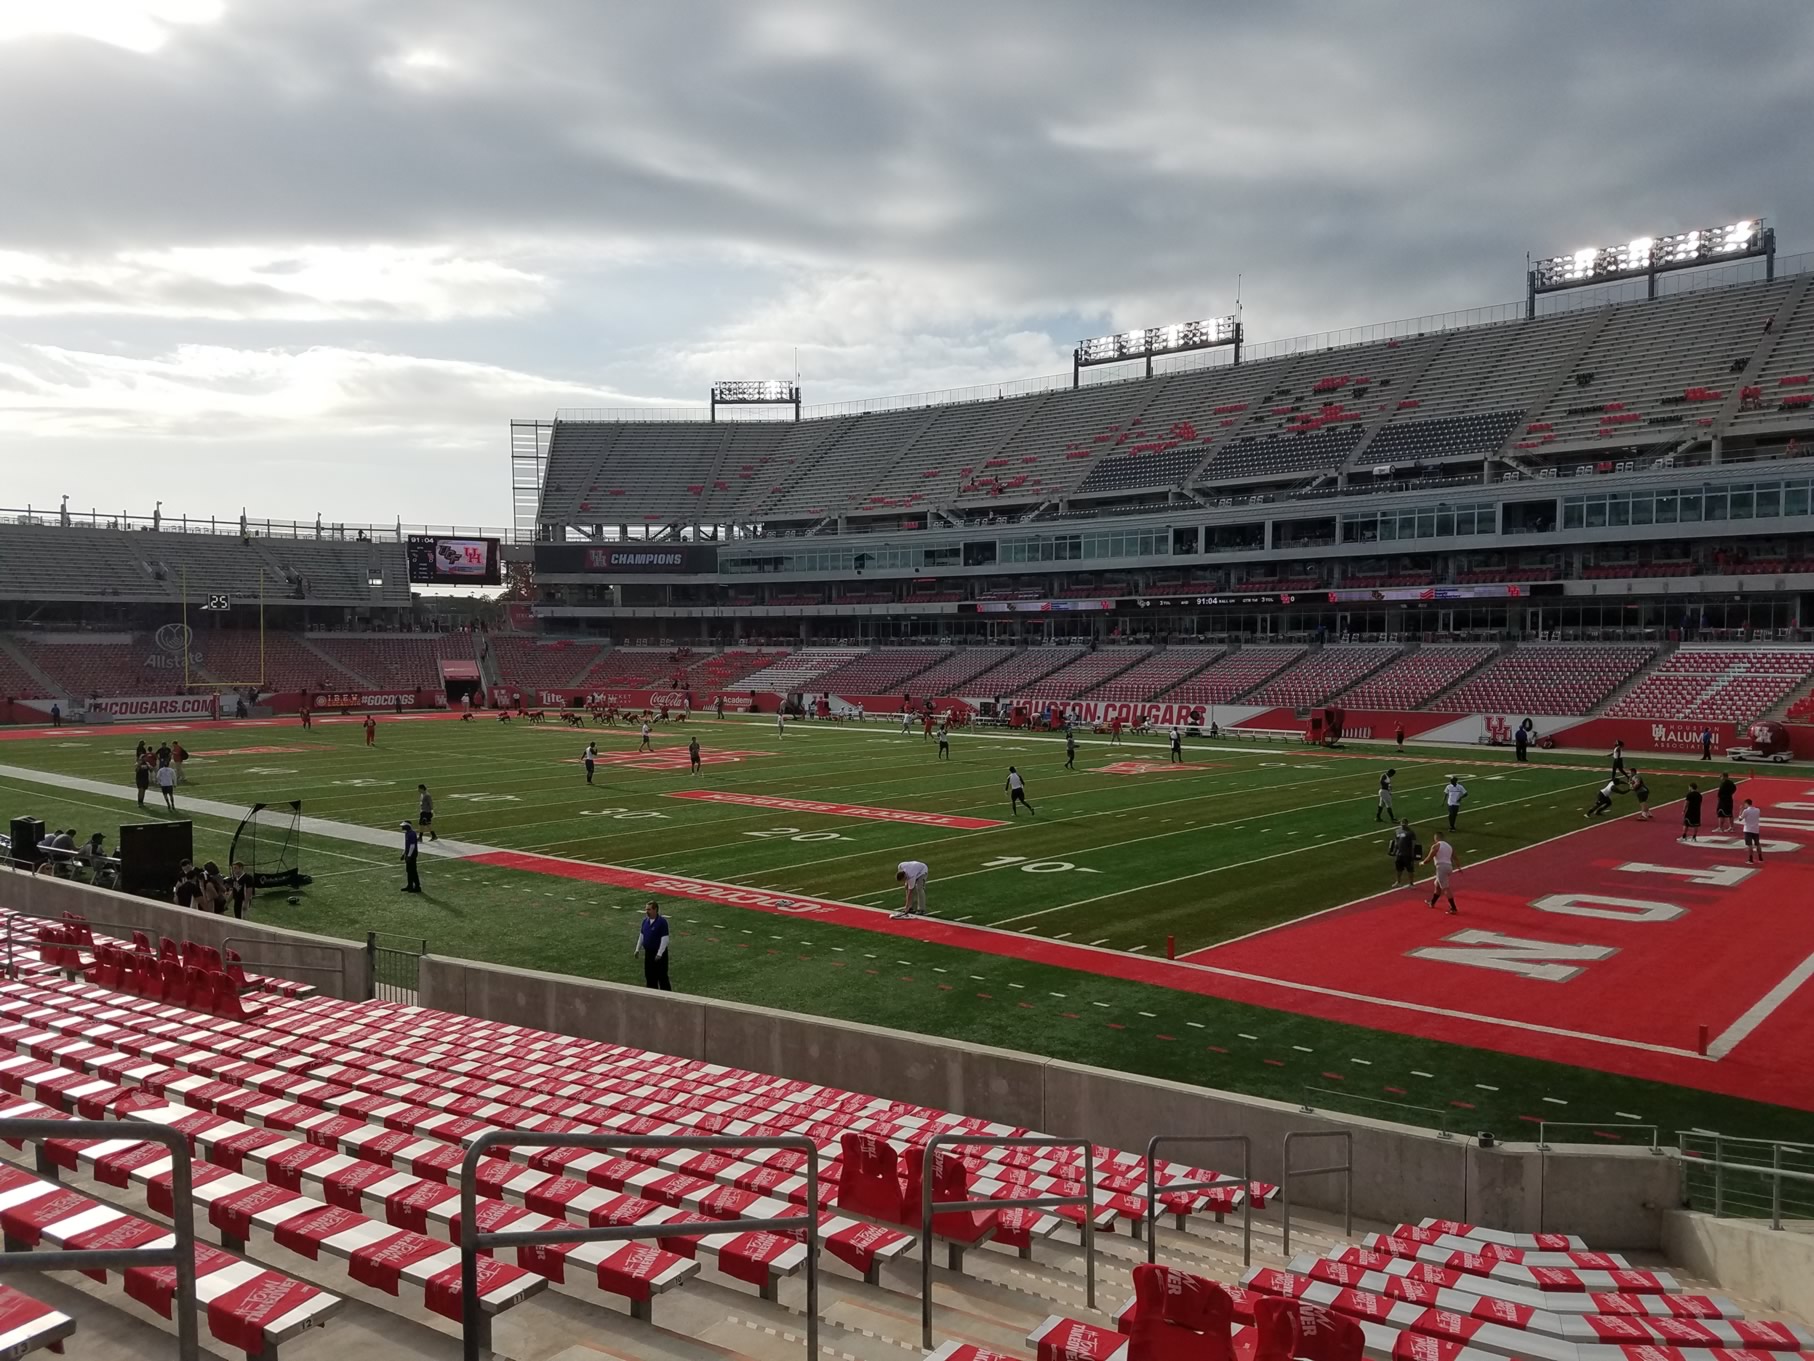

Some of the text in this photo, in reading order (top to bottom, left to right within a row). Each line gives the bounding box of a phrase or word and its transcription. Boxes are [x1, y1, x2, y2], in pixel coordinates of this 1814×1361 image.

[411, 536, 434, 544] 91:04
[610, 553, 682, 564] CHAMPIONS
[210, 595, 228, 609] 25
[143, 651, 204, 669] Allstate
[540, 690, 562, 705] Lite
[723, 695, 753, 705] Academy
[1485, 717, 1512, 743] UH
[743, 827, 840, 841] 20
[980, 856, 1076, 872] 10
[866, 1133, 878, 1158] TAKE
[935, 1150, 944, 1179] TAKE
[301, 1319, 313, 1330] 12
